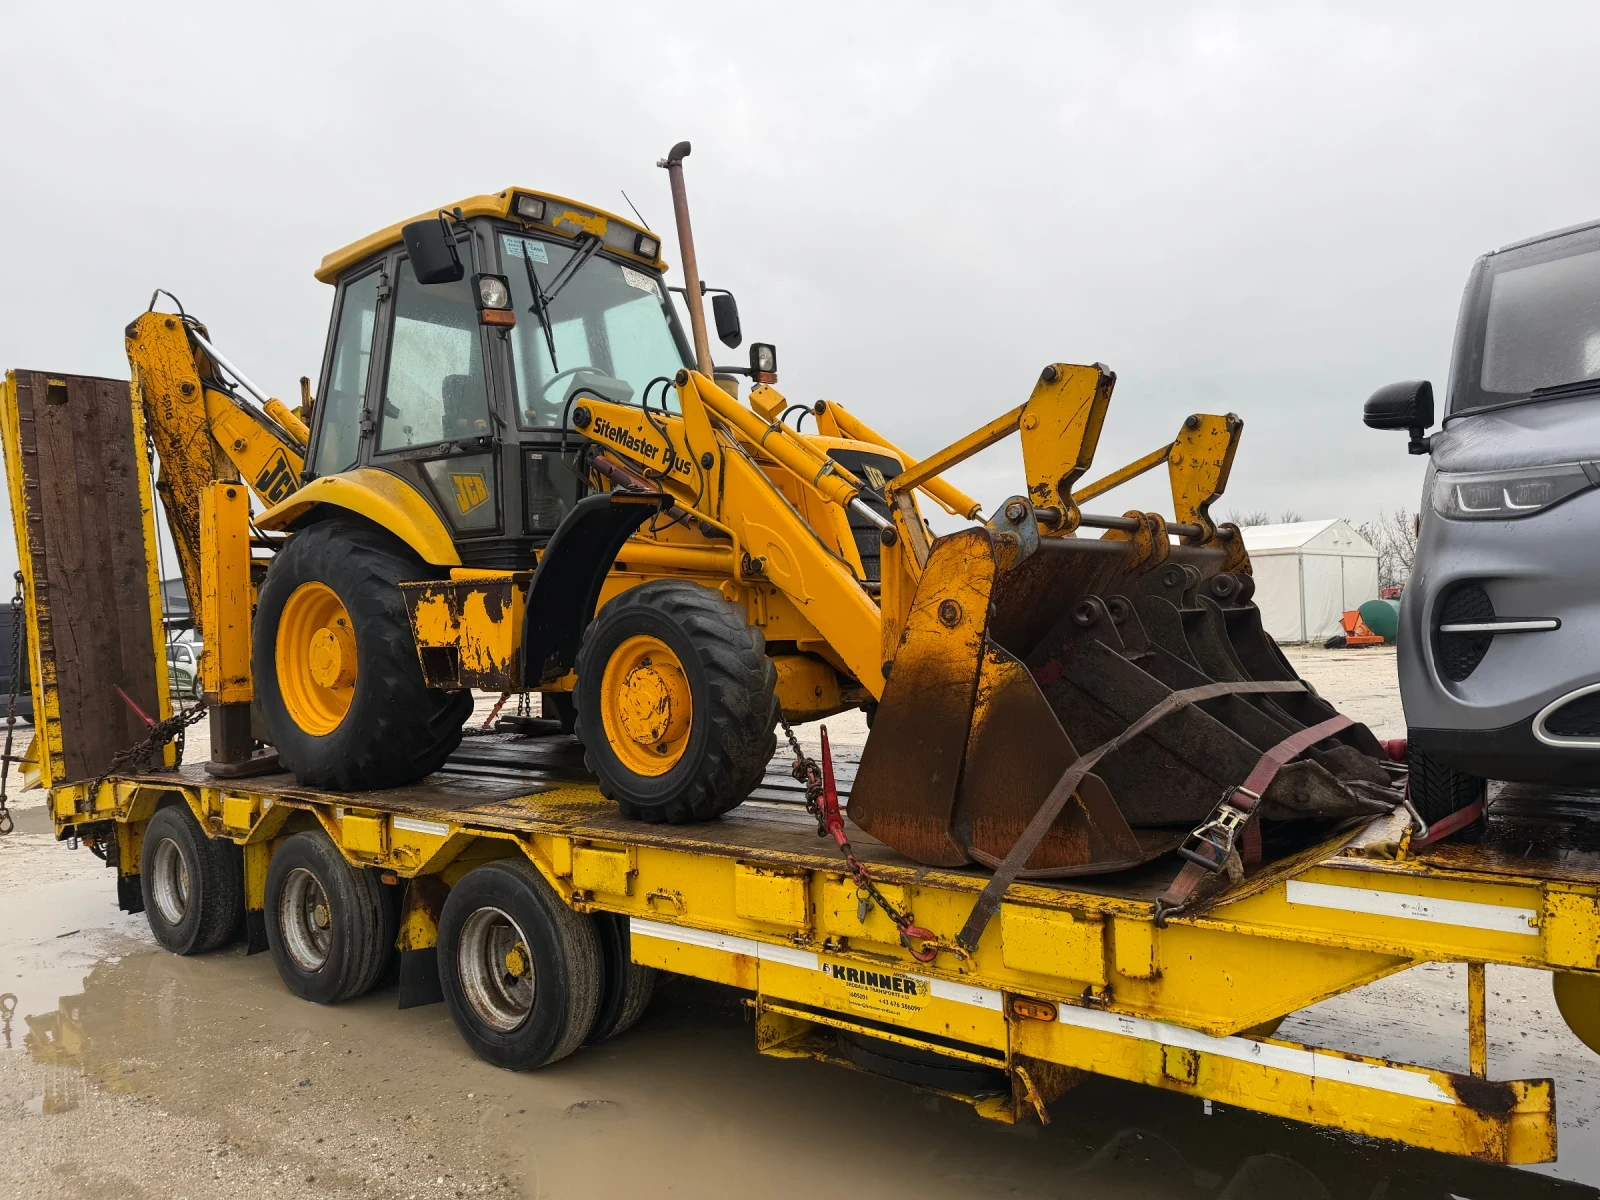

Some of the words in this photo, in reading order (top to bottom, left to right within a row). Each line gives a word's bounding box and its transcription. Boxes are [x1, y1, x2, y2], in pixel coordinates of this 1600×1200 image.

[593, 416, 659, 460] SiteMaster
[662, 447, 692, 475] Pus
[453, 475, 487, 513] JCB
[832, 964, 917, 996] KRINNER
[869, 986, 900, 998] TRANSPORTE
[878, 998, 889, 1006] +43
[901, 1002, 923, 1012] 586099
